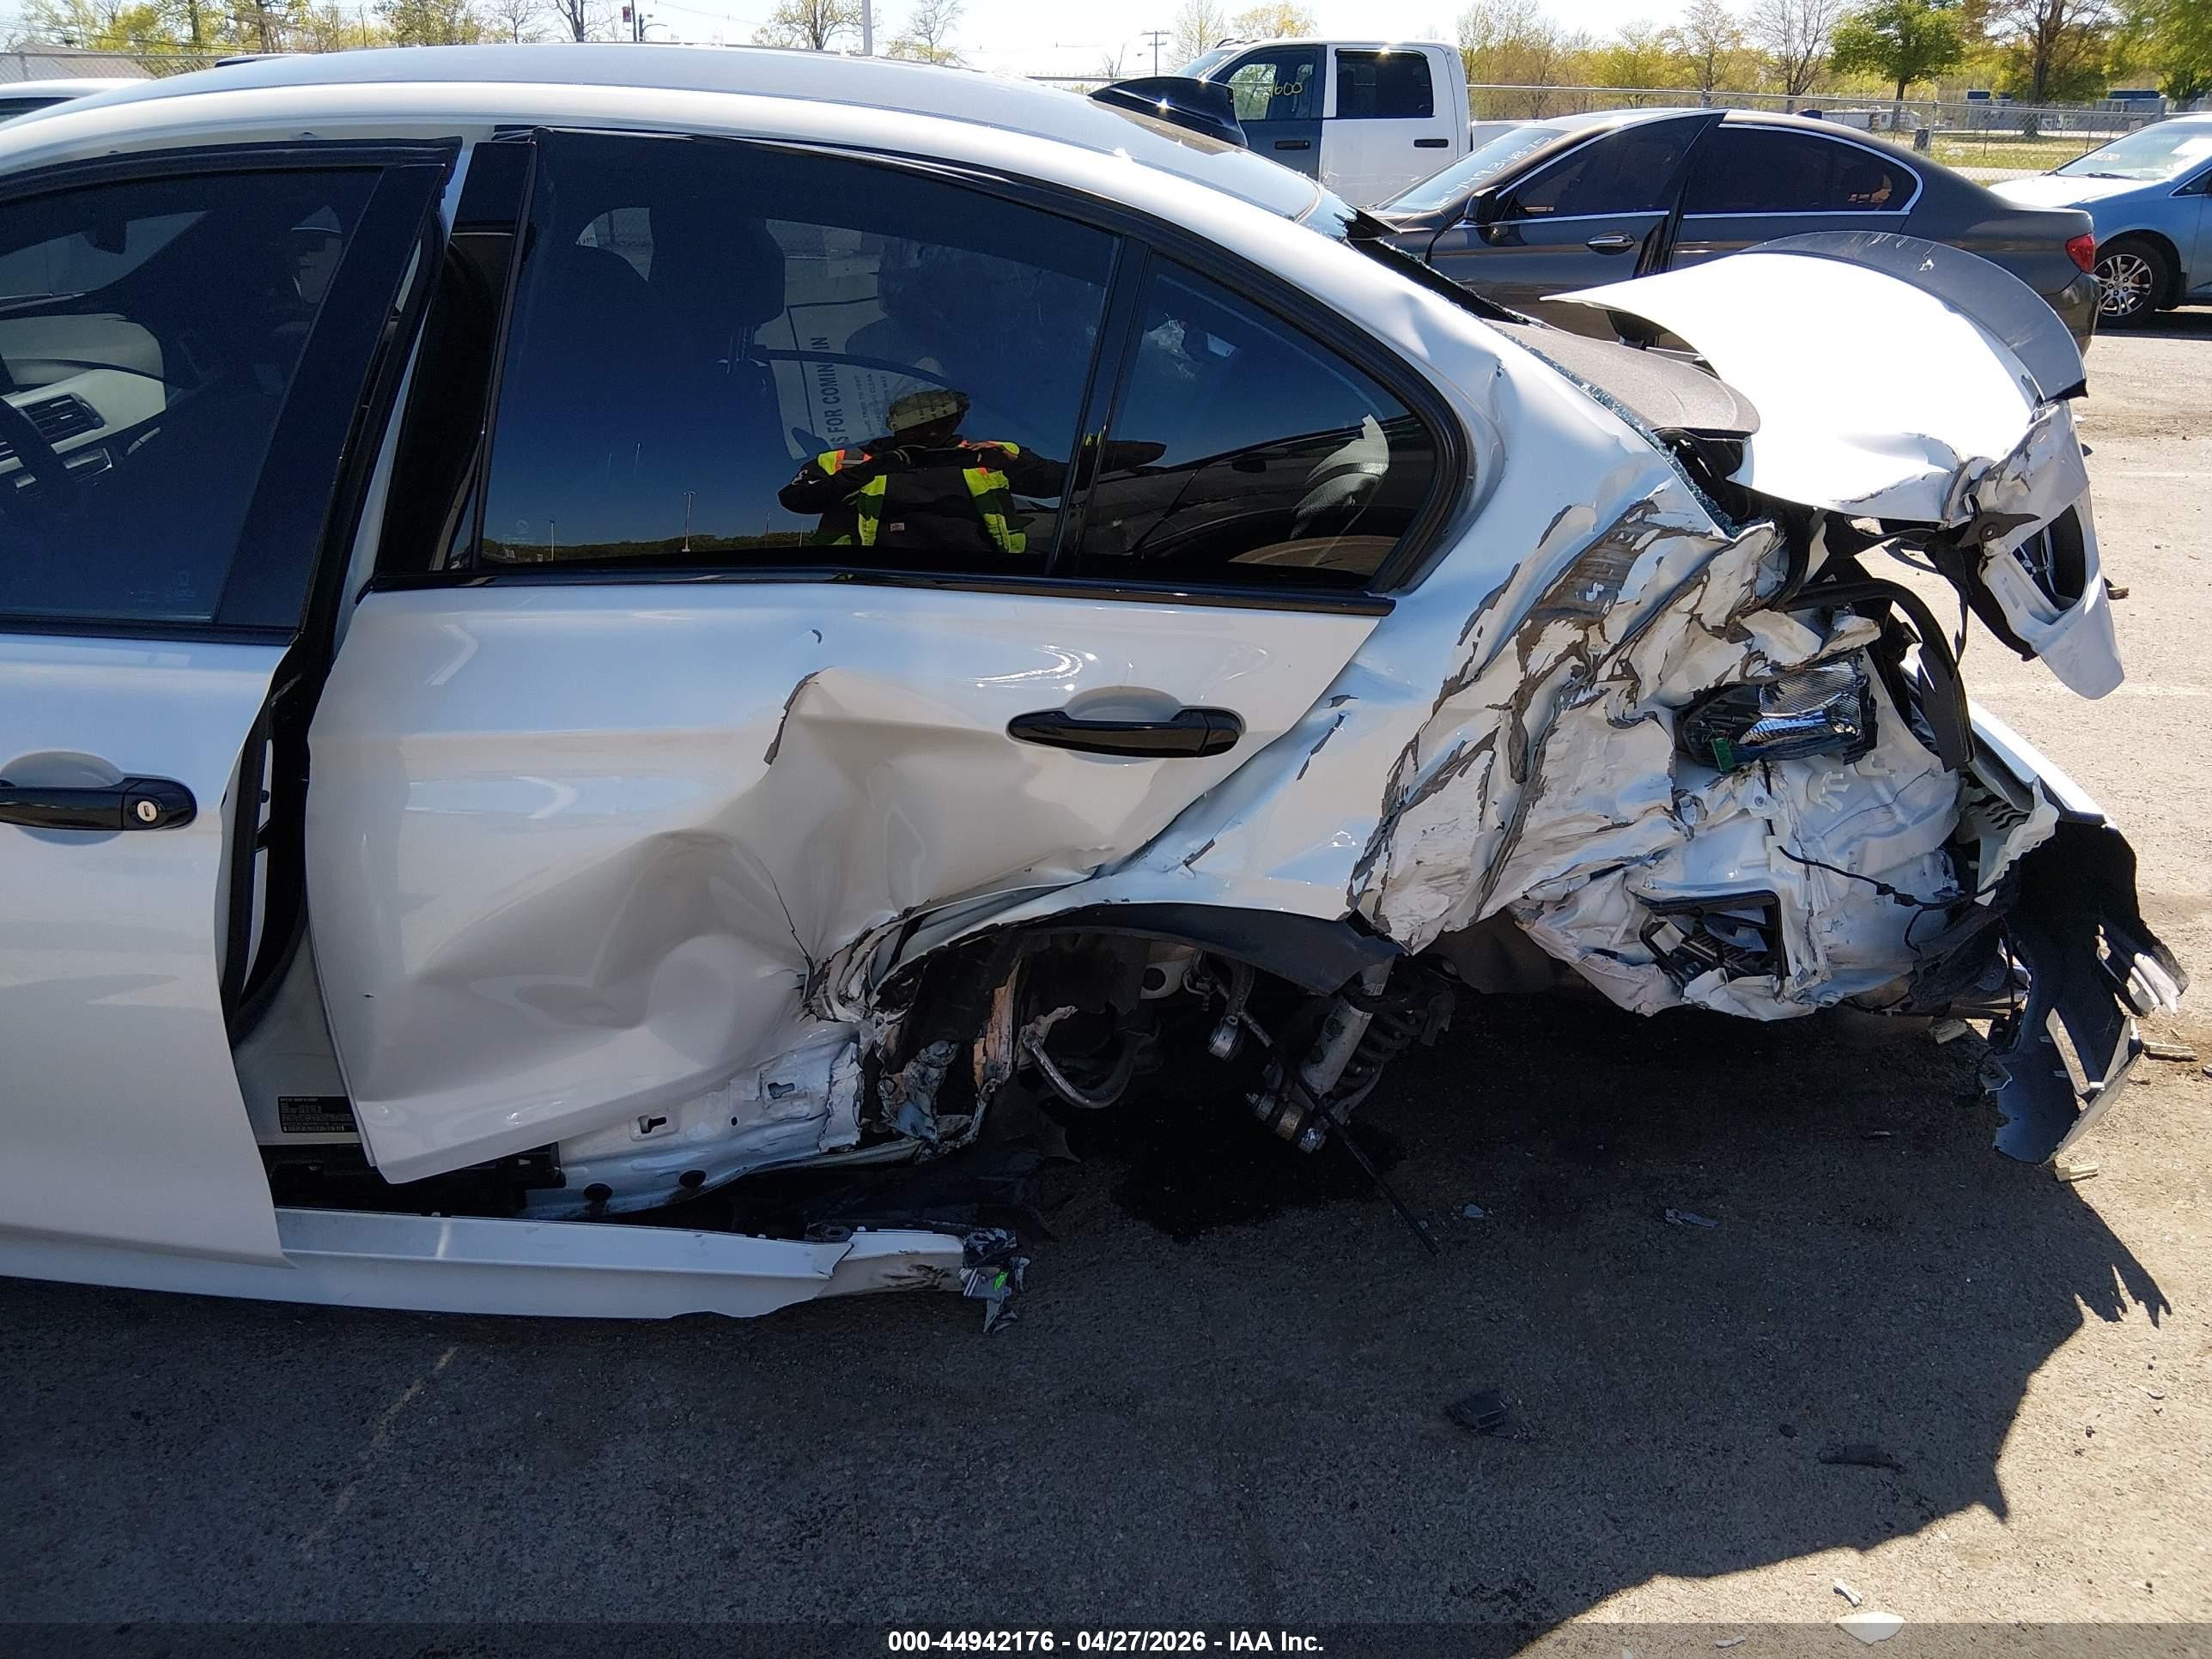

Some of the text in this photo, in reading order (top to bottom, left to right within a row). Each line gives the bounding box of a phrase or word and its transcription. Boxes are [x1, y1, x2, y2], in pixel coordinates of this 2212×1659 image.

[810, 337, 830, 349] IN
[817, 363, 842, 404] COMIN
[823, 408, 846, 434] FOR
